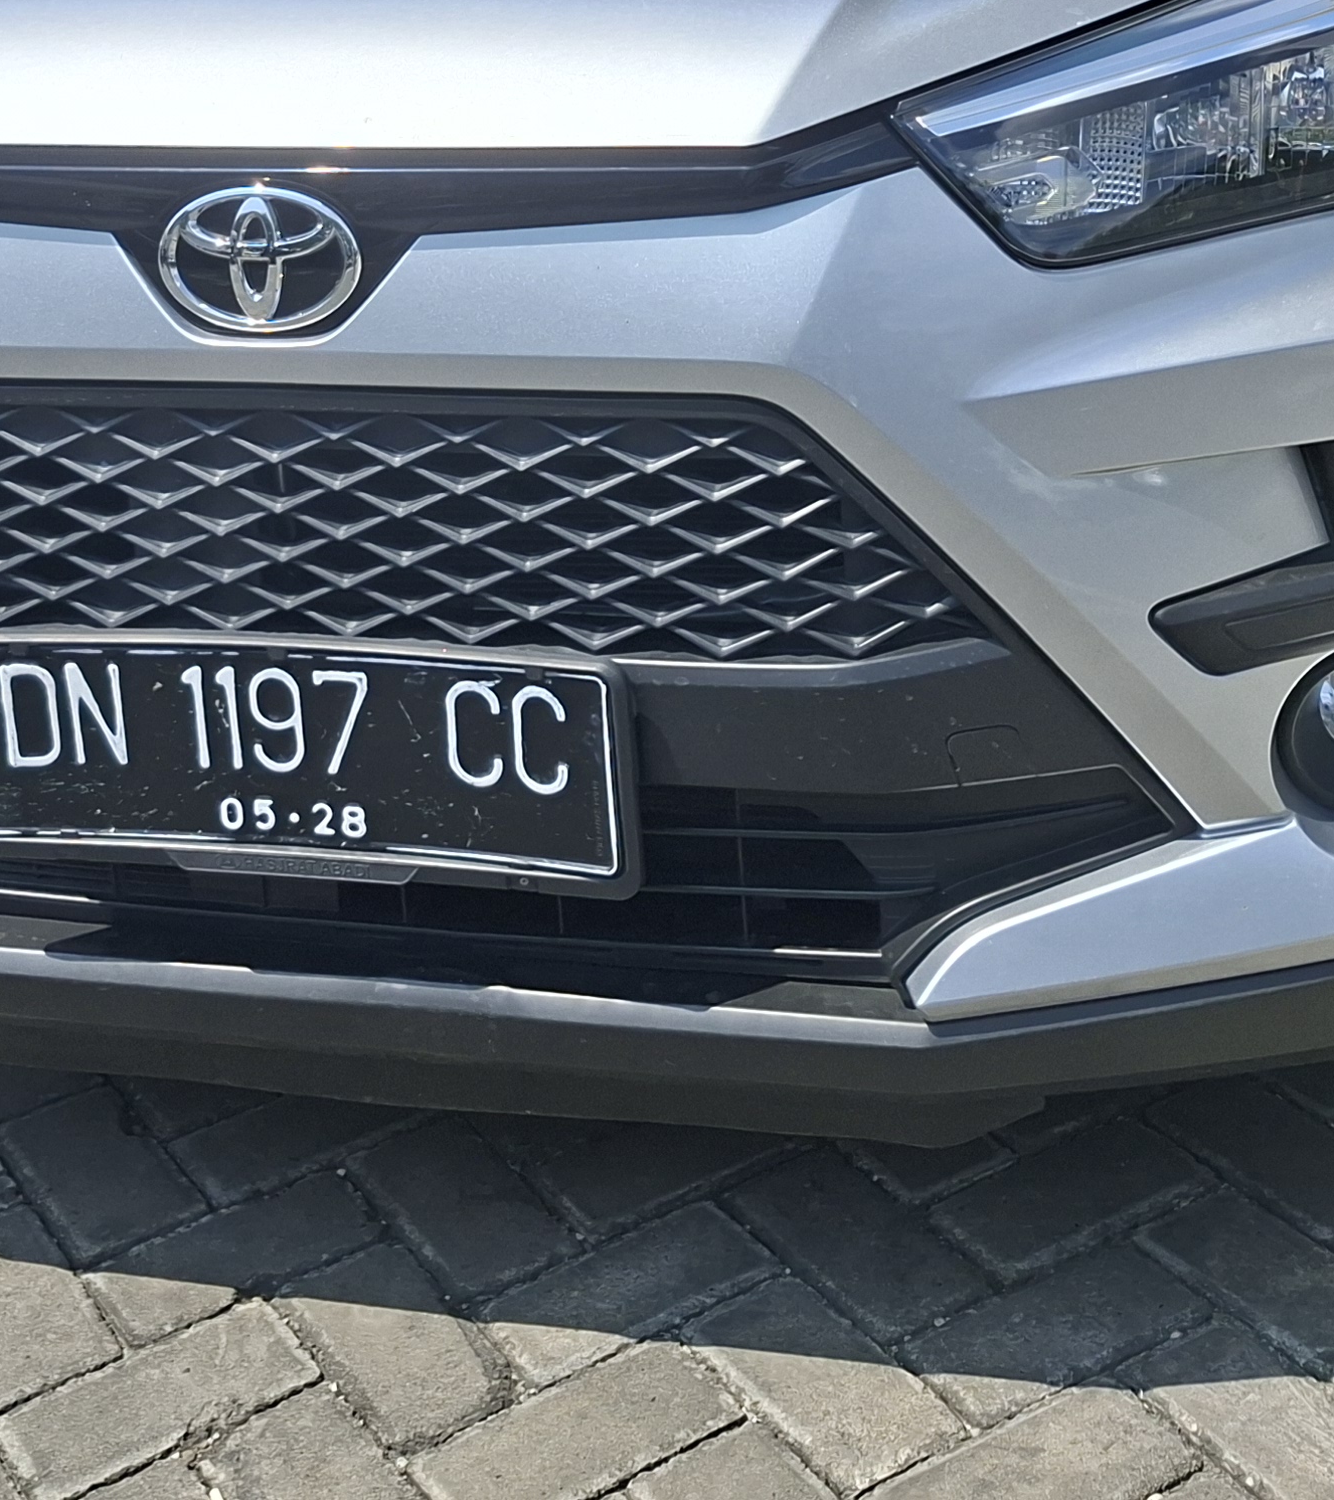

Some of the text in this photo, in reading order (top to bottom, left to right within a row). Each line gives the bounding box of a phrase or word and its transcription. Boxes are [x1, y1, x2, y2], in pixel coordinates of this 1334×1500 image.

[180, 664, 369, 775] 1197
[444, 680, 569, 795] CC
[321, 861, 371, 879] ABADI
